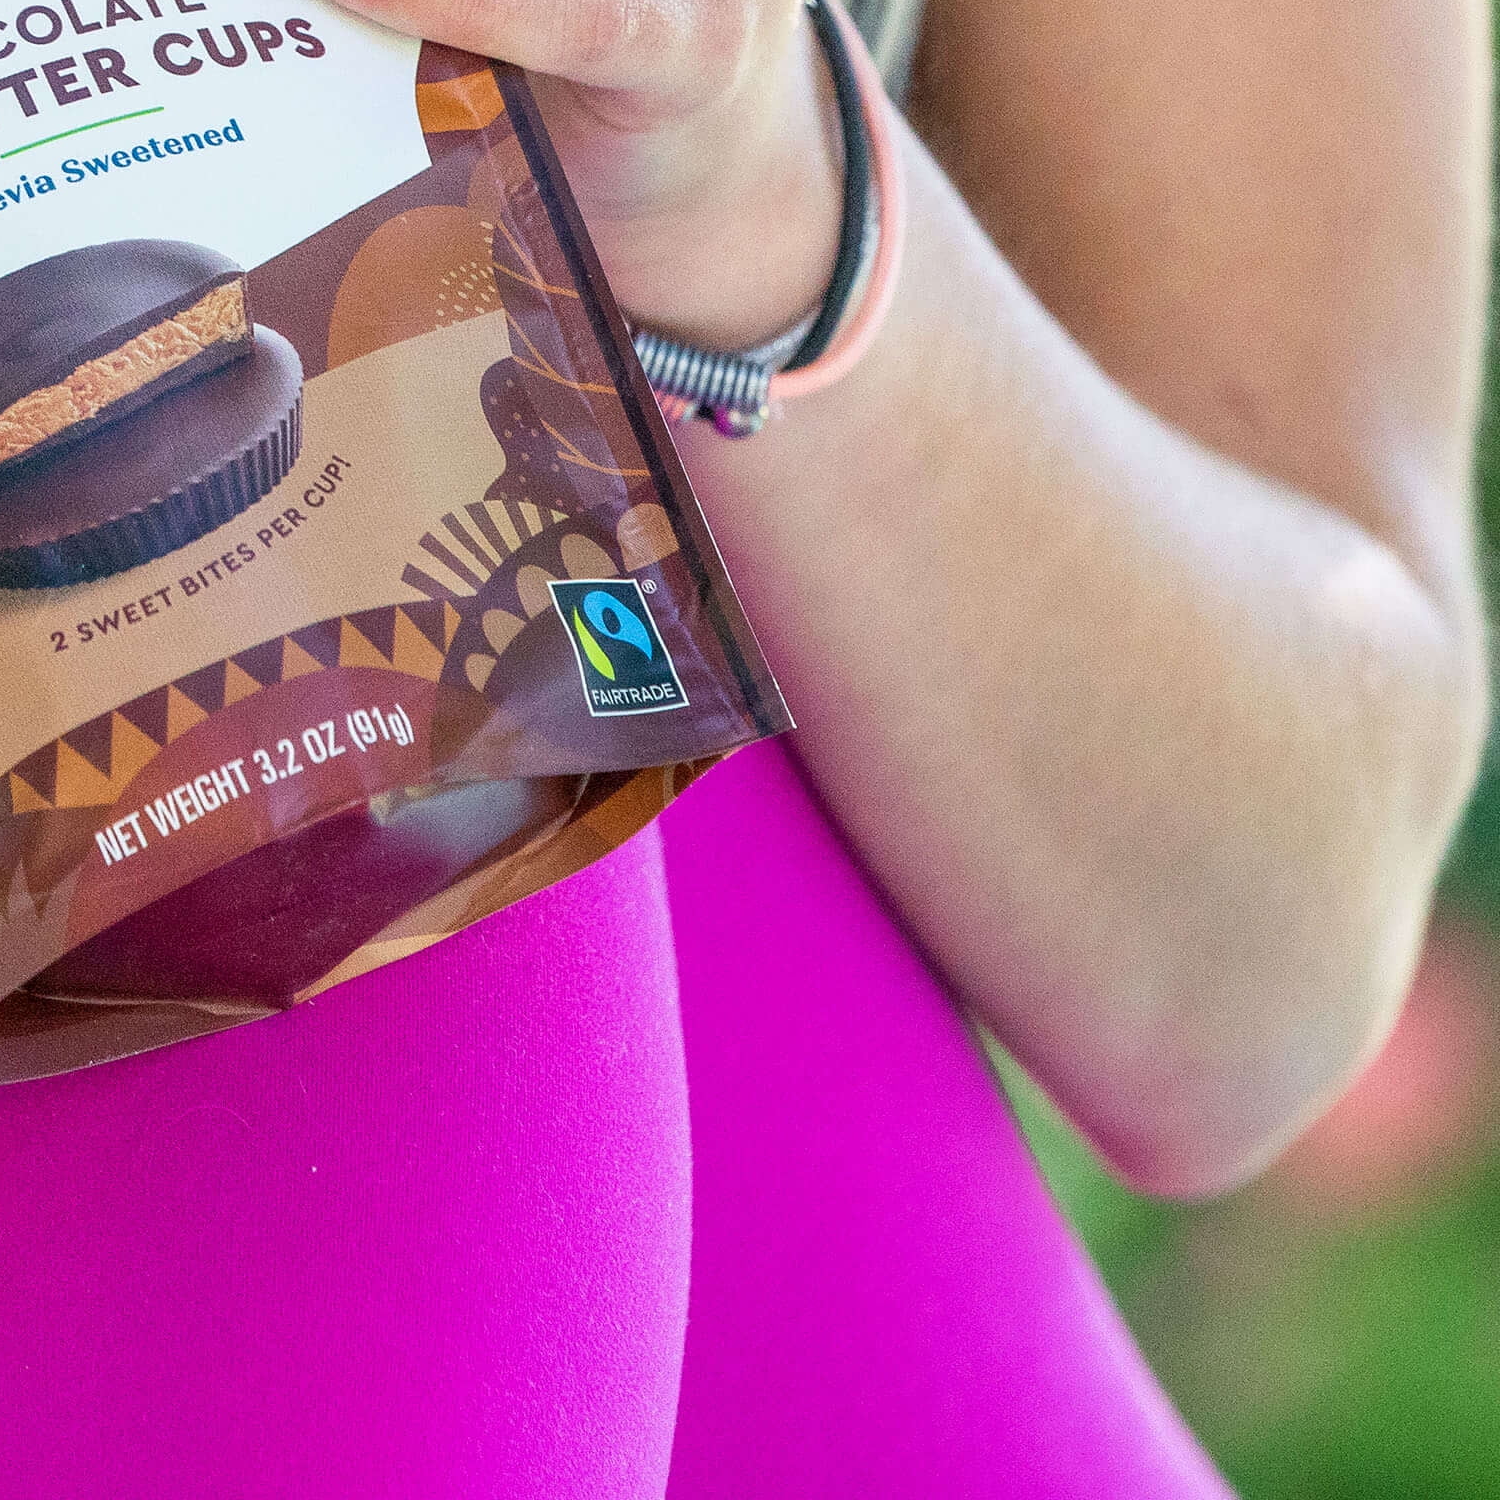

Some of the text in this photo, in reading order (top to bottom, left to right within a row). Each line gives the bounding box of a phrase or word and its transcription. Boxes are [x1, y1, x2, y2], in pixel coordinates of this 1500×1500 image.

[152, 17, 327, 76] CUPS
[60, 118, 246, 185] Sweetened
[49, 454, 352, 652] 2 SWEET BITES PER CUP!
[591, 682, 677, 706] FAIRTRADE
[94, 703, 417, 866] NET WEIGHT 3.2 OZ (91g)
